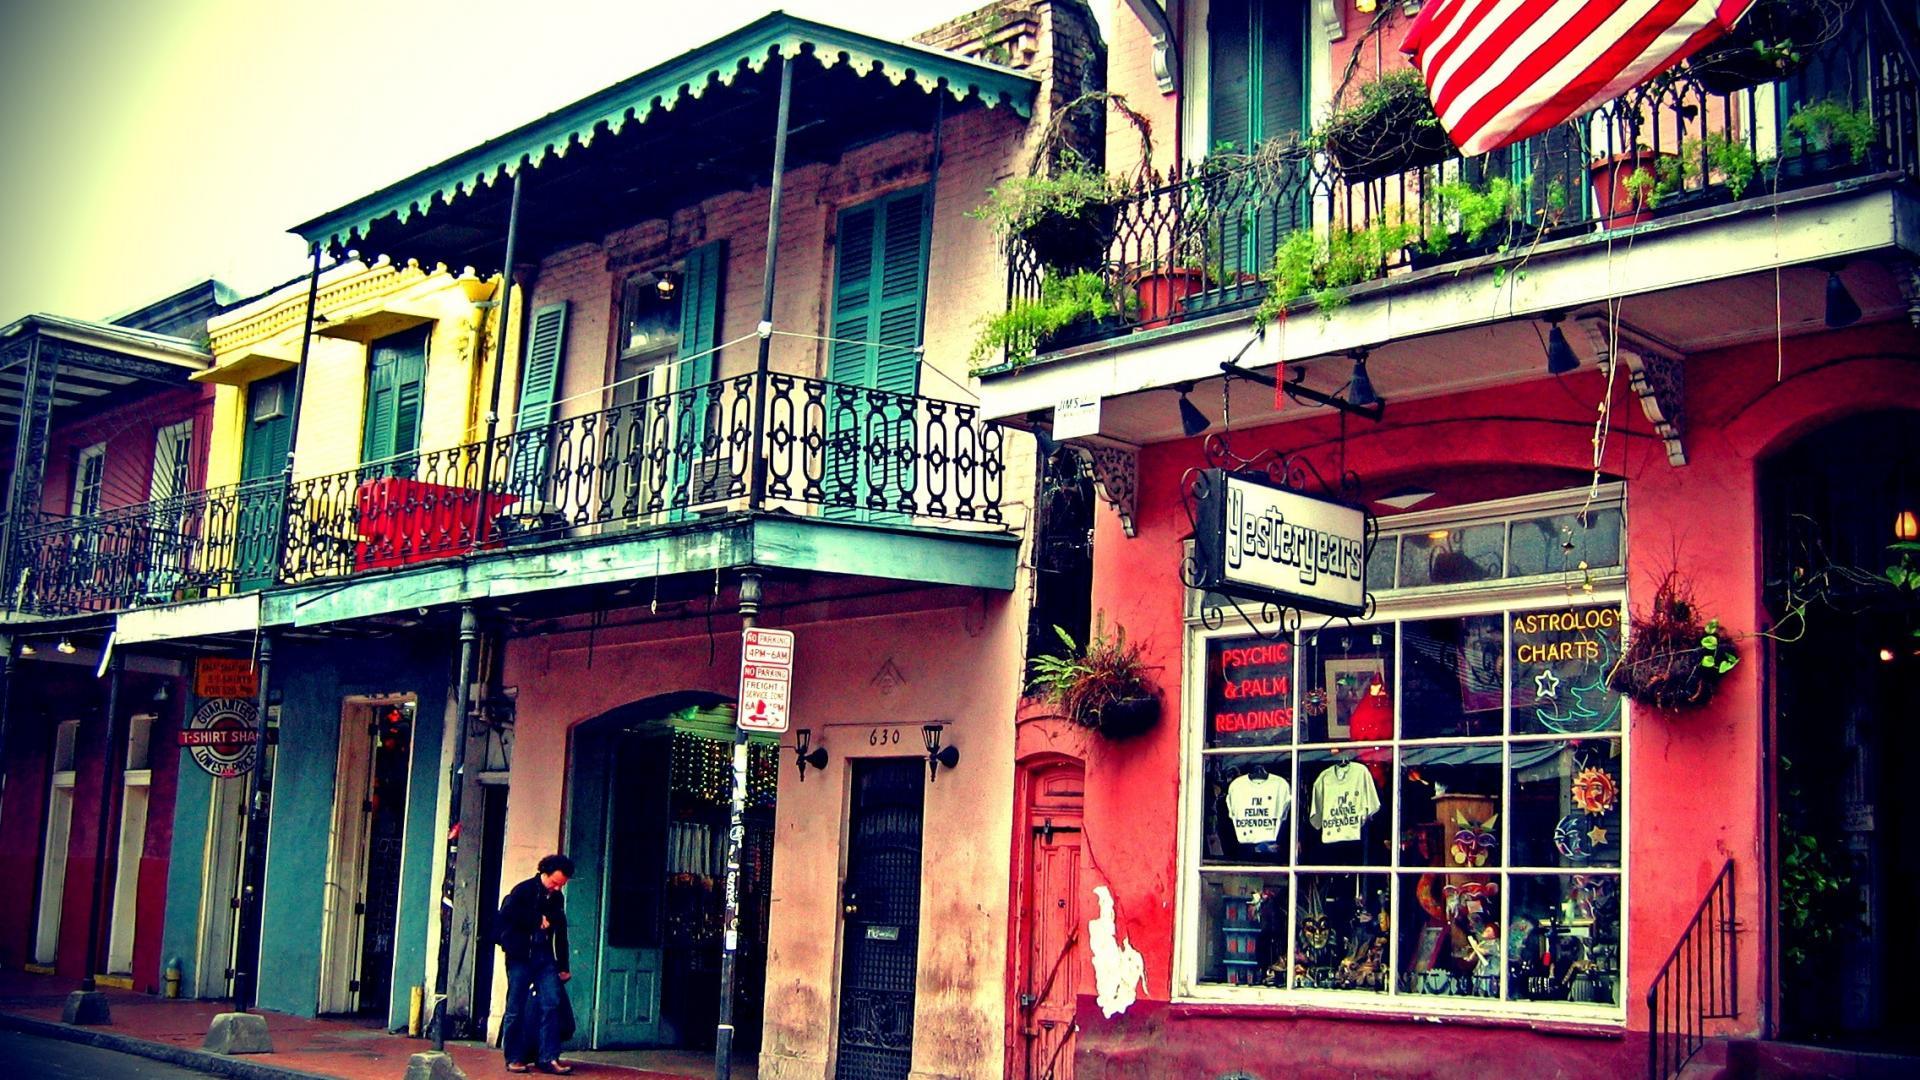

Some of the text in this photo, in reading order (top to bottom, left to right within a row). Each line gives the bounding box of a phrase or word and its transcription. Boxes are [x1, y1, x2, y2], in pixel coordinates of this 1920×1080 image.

[1514, 608, 1622, 634] ASTROLOGY
[748, 632, 789, 645] NO PARKING
[1222, 642, 1289, 667] PSYCHIC
[1517, 640, 1599, 663] CHARTS
[744, 667, 786, 679] NO PARKING
[746, 681, 778, 690] FREIGHT
[746, 690, 785, 700] SERVICE ZONE
[1225, 676, 1287, 699] & PALM
[196, 700, 257, 724] GUARANTEED
[1216, 707, 1293, 732] READINGS
[870, 728, 900, 747] 630
[196, 749, 229, 774] LOWEST
[1244, 808, 1269, 817] FELINE
[1330, 805, 1356, 817] CANINE
[1236, 818, 1278, 828] DEPENDENT
